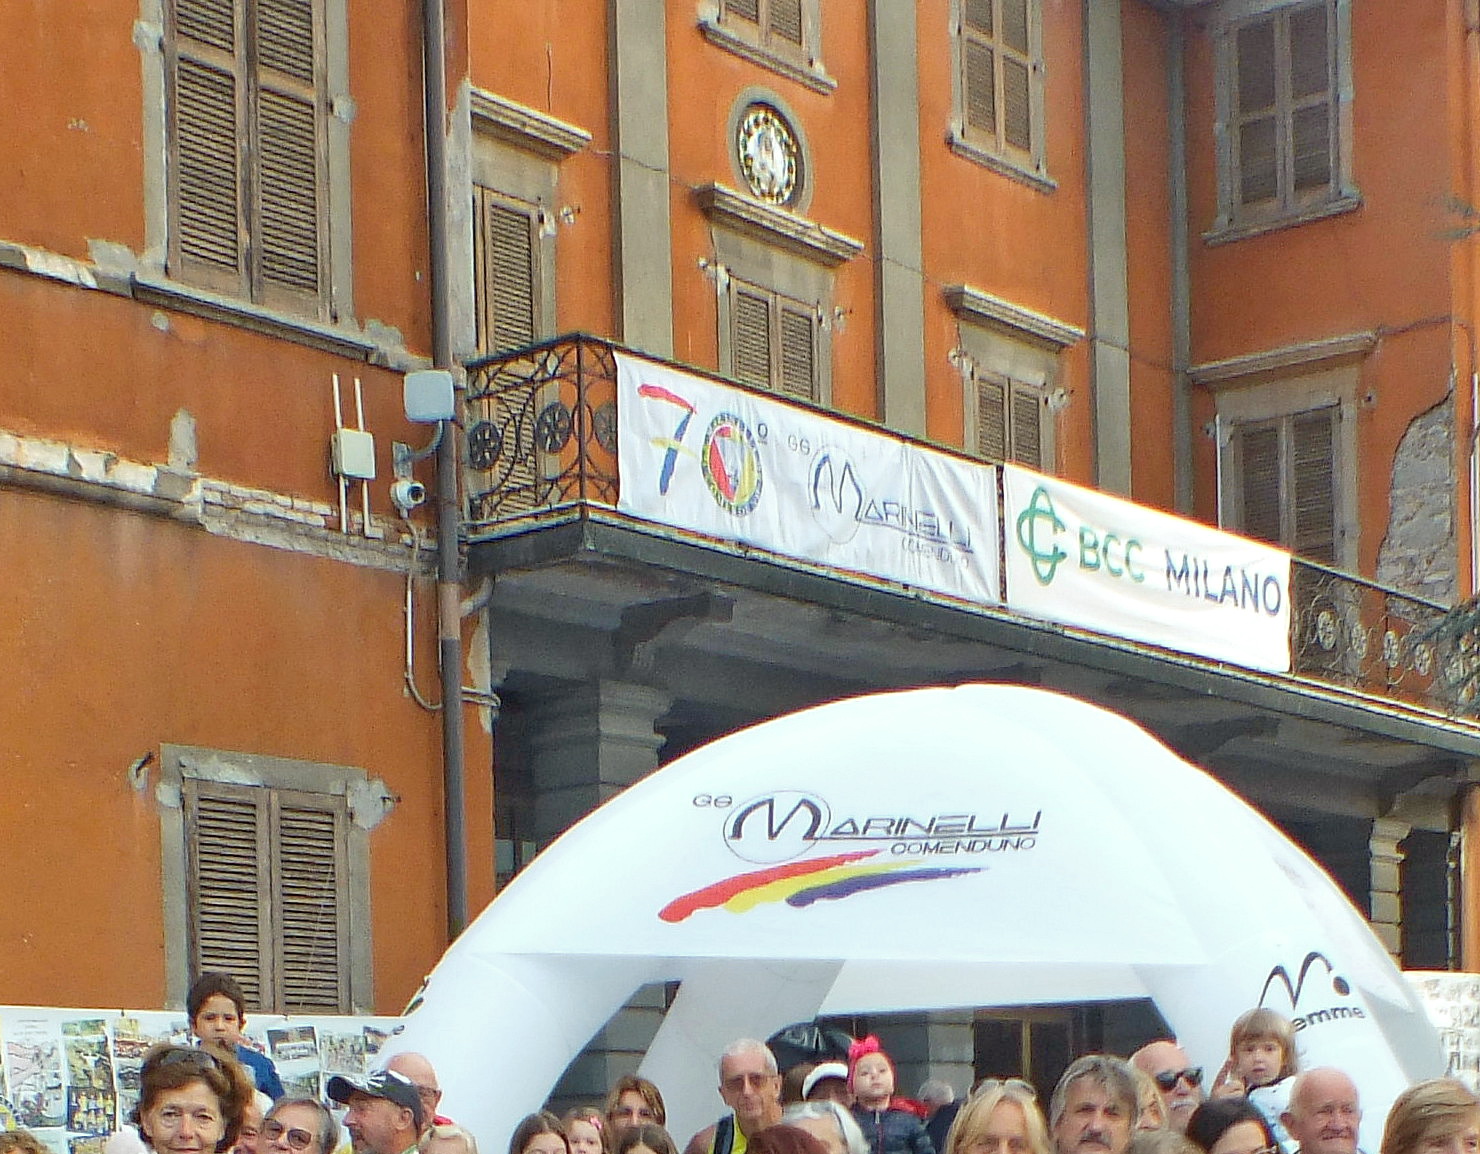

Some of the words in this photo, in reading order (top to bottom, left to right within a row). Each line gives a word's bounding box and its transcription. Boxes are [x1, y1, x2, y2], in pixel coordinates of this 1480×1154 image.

[1078, 526, 1145, 584] BCC
[1165, 548, 1282, 617] MILANO
[728, 797, 1042, 842] MARINELLI
[891, 837, 1037, 857] COMENDUNO
